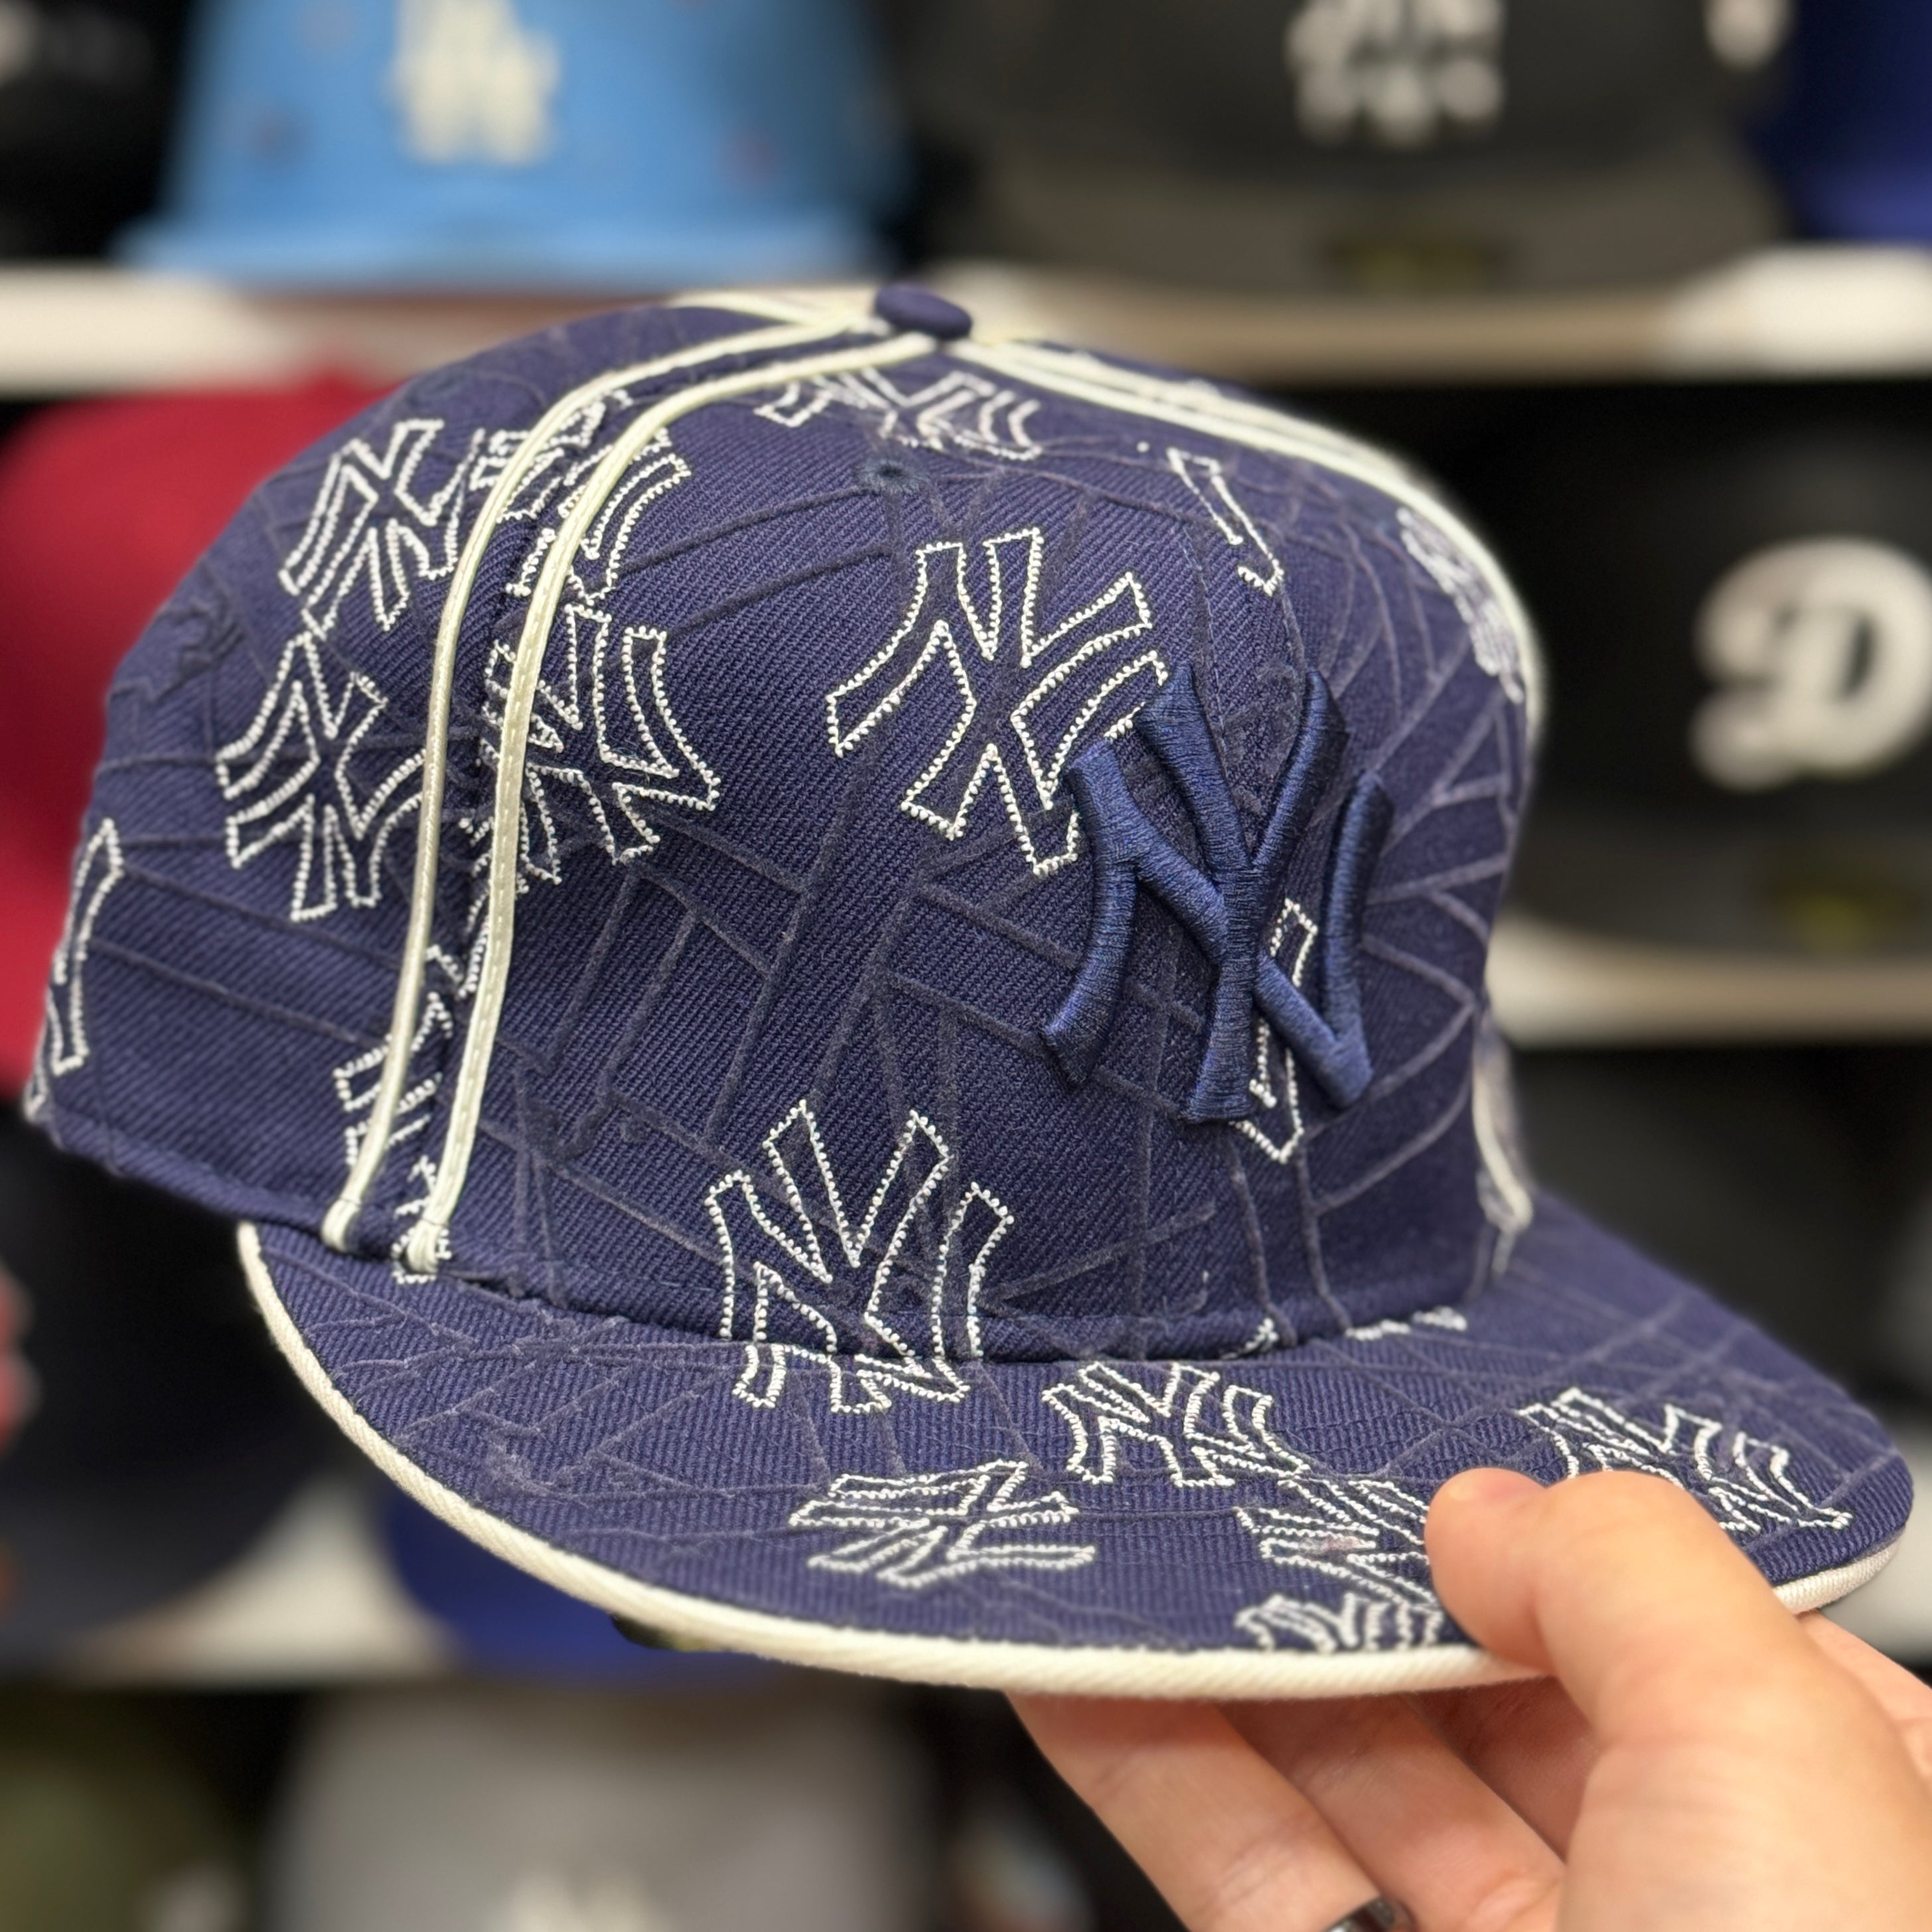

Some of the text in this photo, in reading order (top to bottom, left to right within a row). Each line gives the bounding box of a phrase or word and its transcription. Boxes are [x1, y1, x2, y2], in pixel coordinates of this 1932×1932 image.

[825, 527, 1169, 876] NY
[1692, 541, 1932, 788] D
[1039, 666, 1394, 1123] NY
[705, 1099, 1015, 1414] NY
[789, 1458, 1098, 1588] NY
[1041, 1360, 1313, 1488] NY
